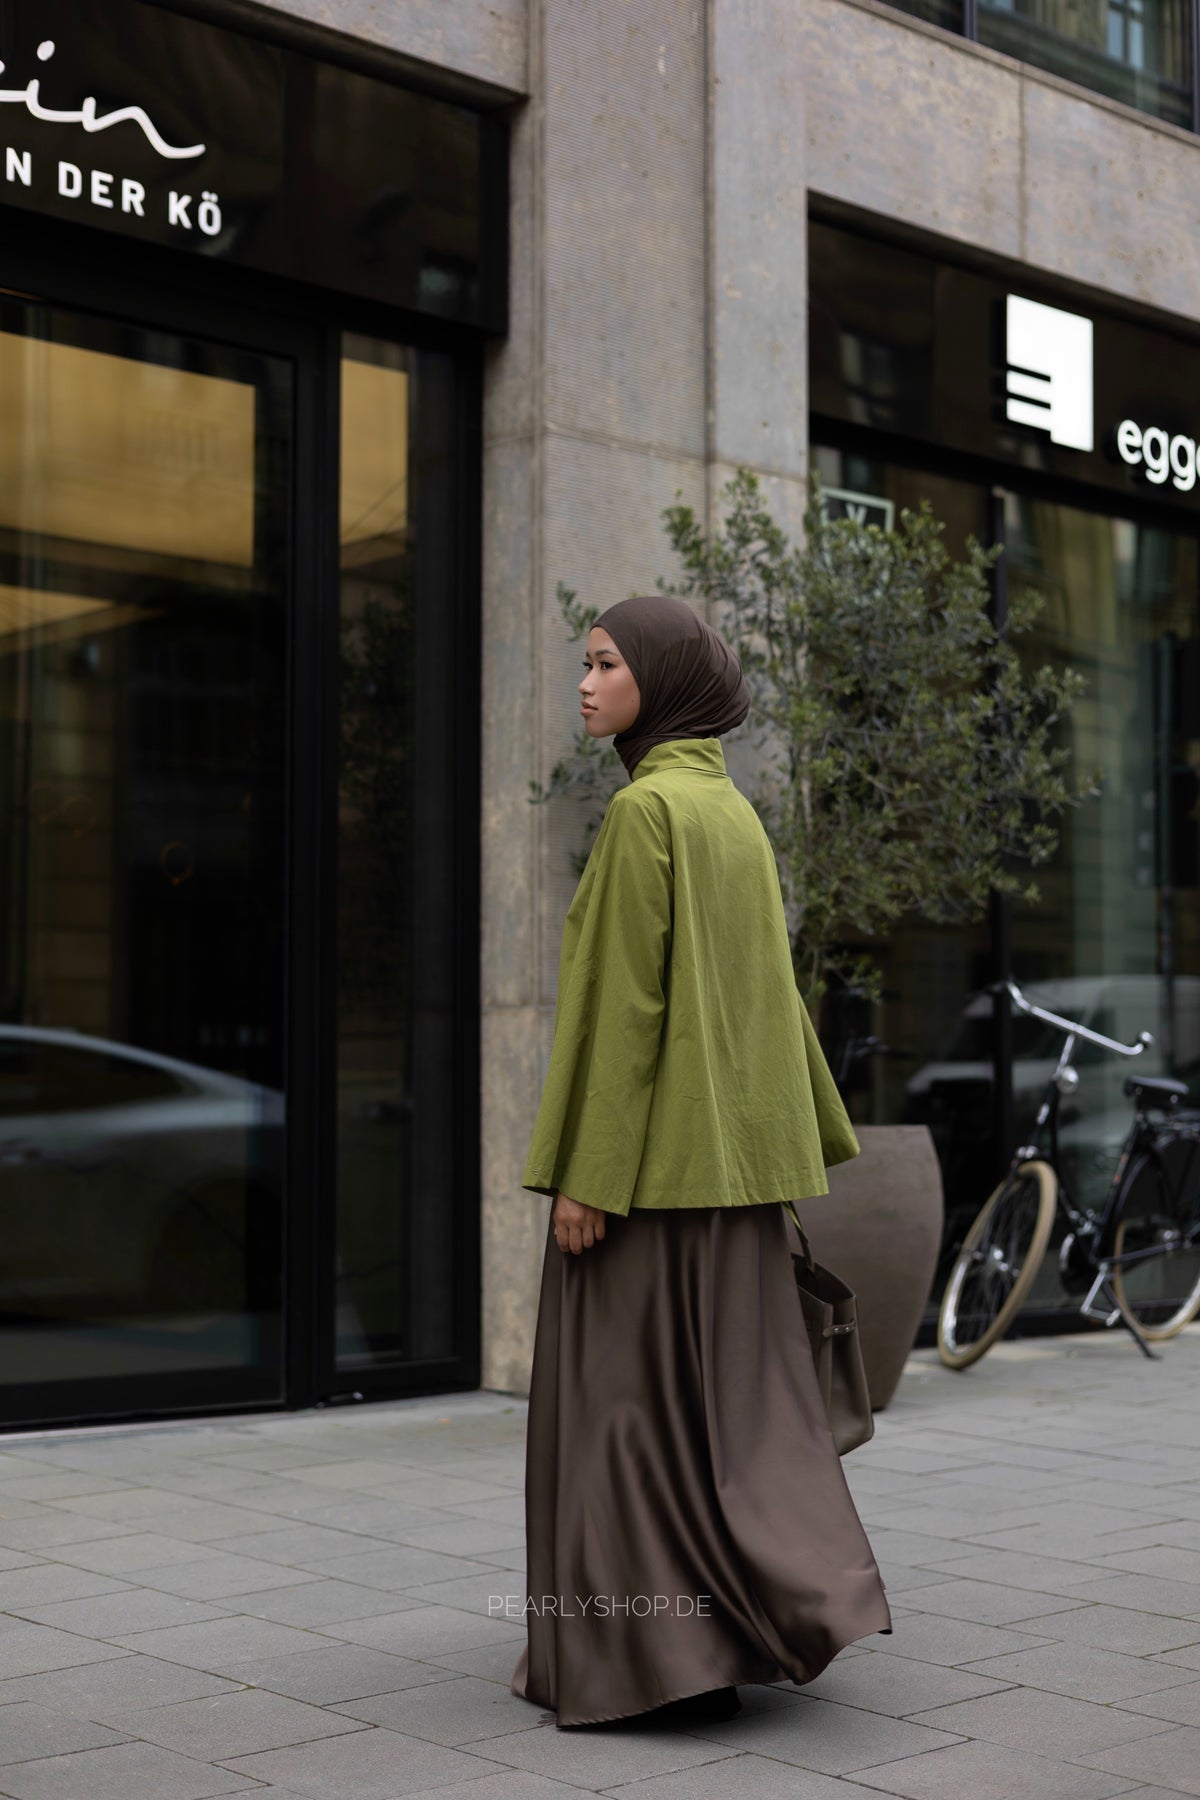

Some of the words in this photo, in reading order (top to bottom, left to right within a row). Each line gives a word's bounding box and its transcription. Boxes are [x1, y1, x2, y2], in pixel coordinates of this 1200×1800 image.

[0, 40, 206, 159] in
[58, 160, 146, 217] DER
[168, 190, 222, 236] KÖ
[1117, 419, 1200, 491] egg
